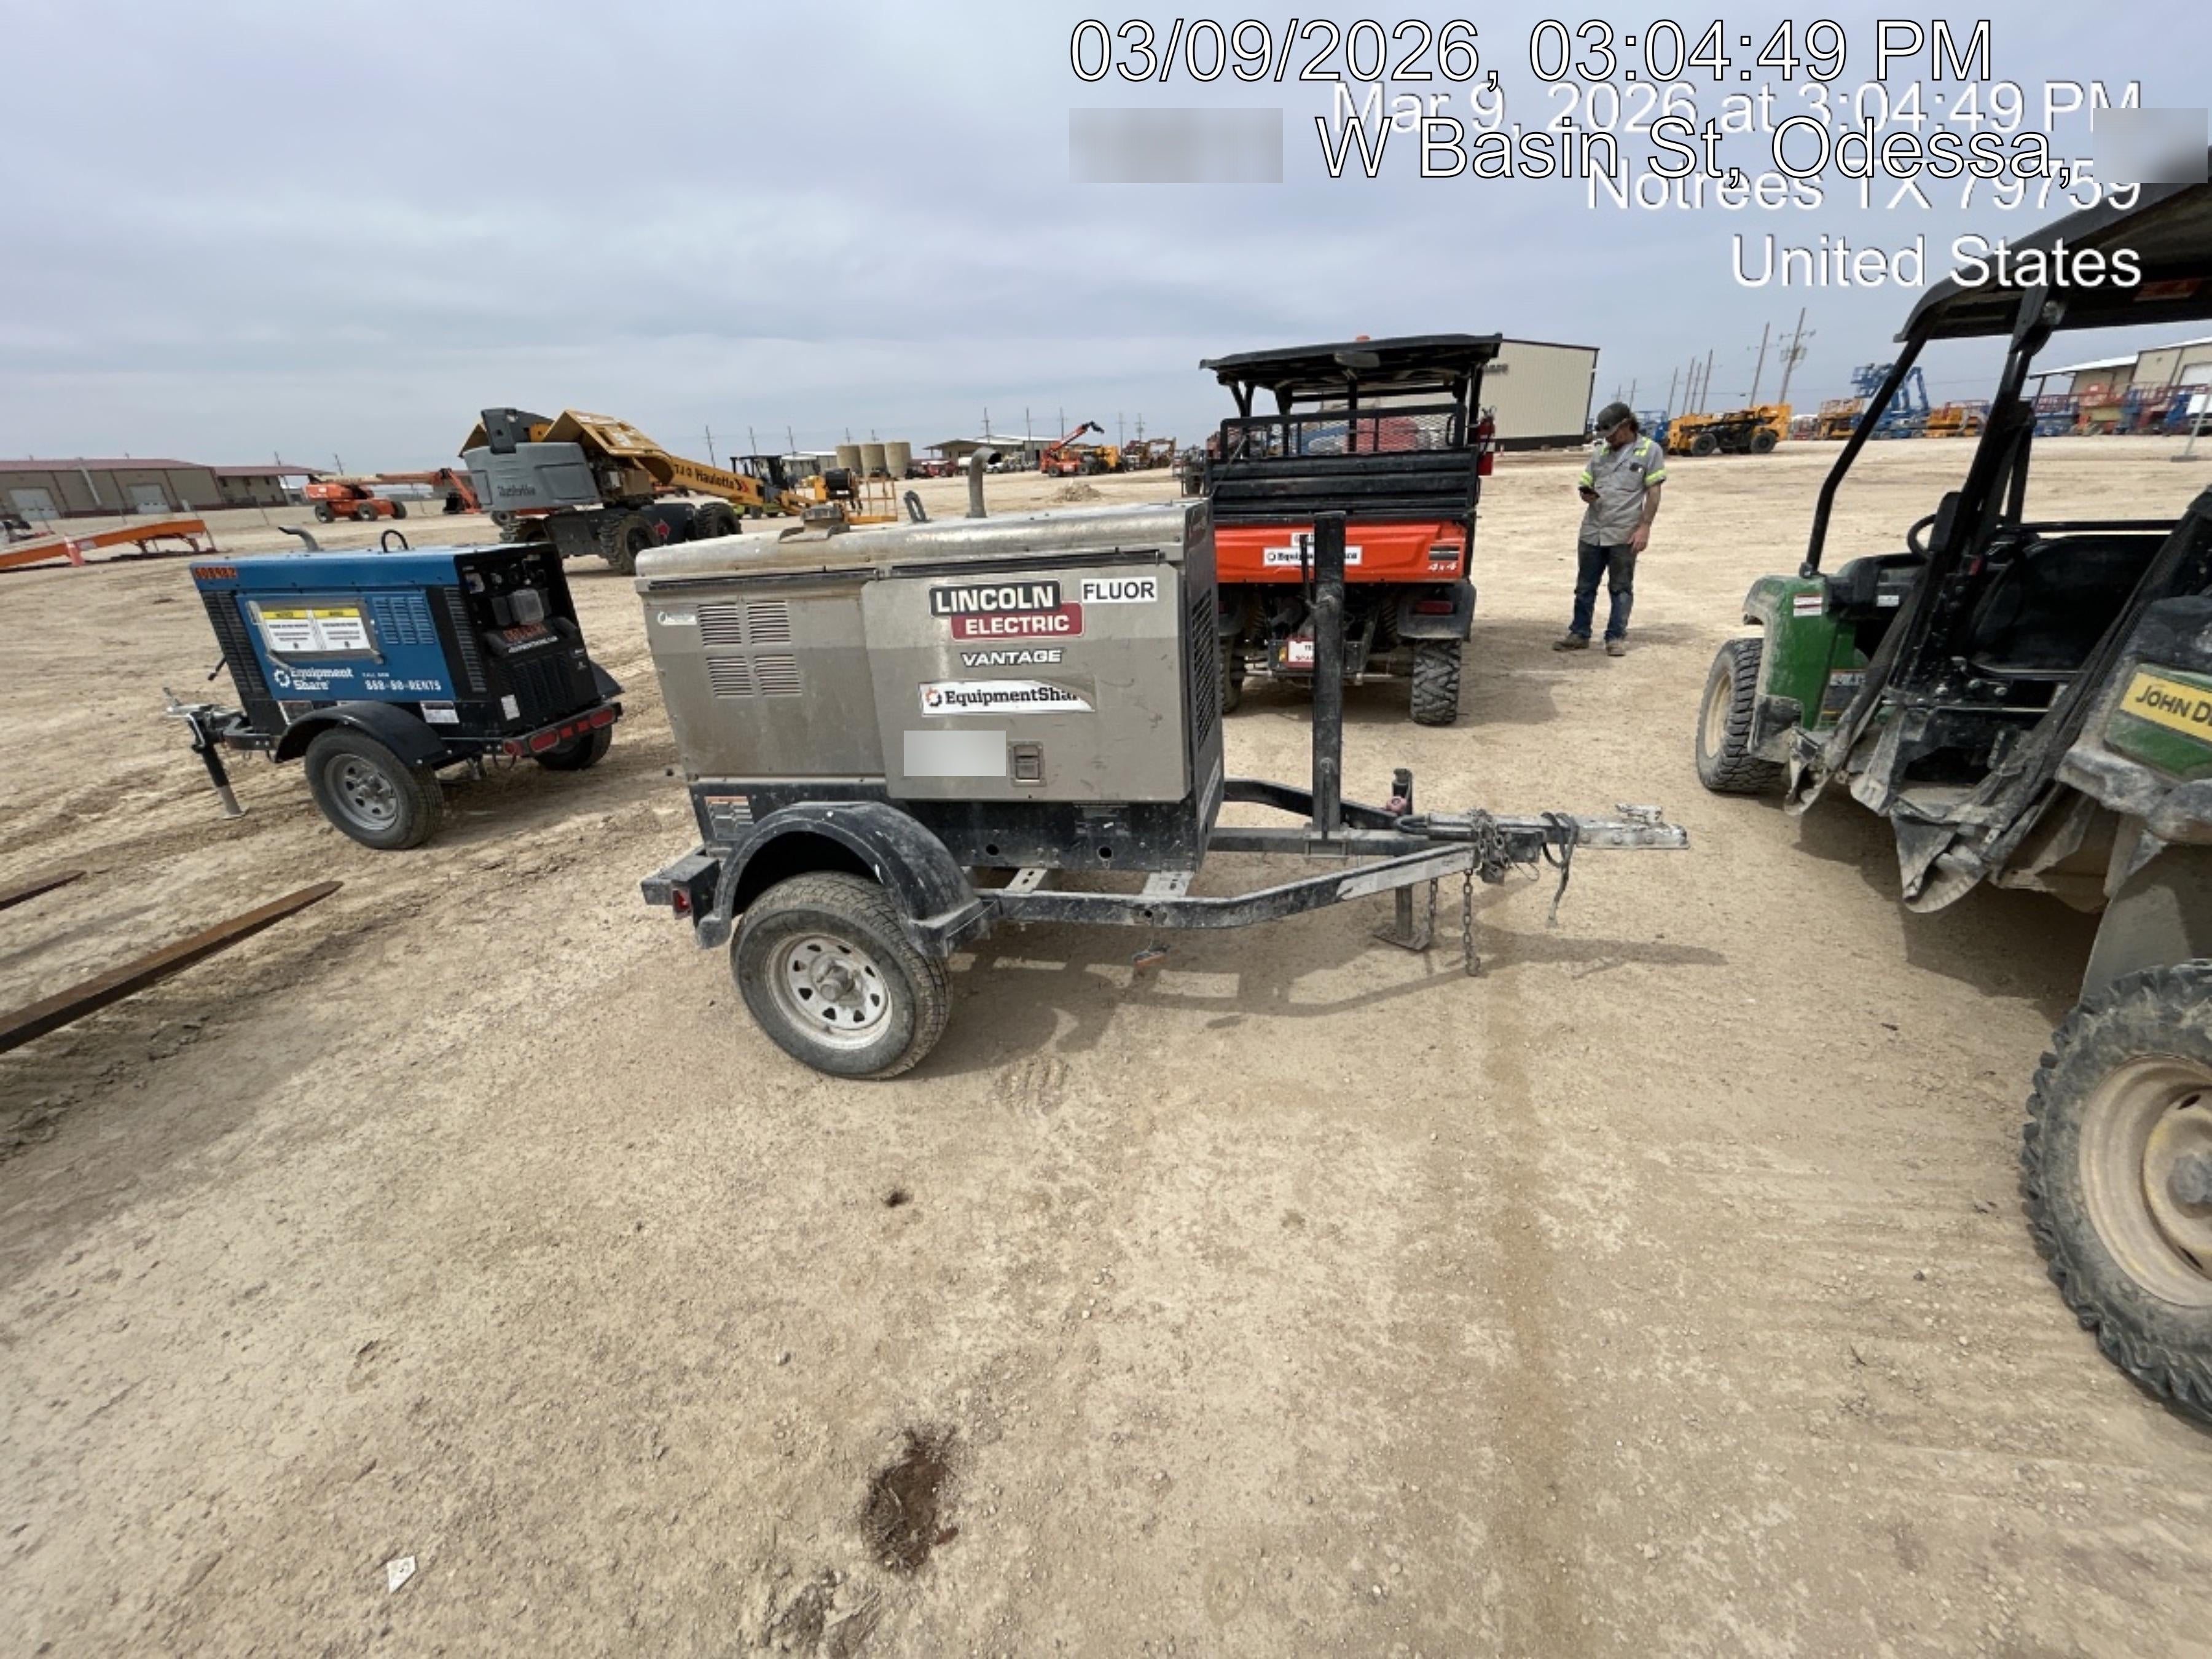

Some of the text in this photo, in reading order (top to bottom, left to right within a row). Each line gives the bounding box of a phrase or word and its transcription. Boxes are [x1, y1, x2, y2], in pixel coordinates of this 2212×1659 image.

[936, 586, 1054, 613] LINCOLN
[1083, 582, 1155, 601] FLUOR
[965, 614, 1070, 635] ELECTRIC
[961, 649, 1063, 667] VANTAGE
[291, 667, 353, 680] Equipment
[294, 680, 328, 690] Share
[944, 687, 1077, 706] EquipmentSha
[2135, 684, 2192, 718] JOHN
